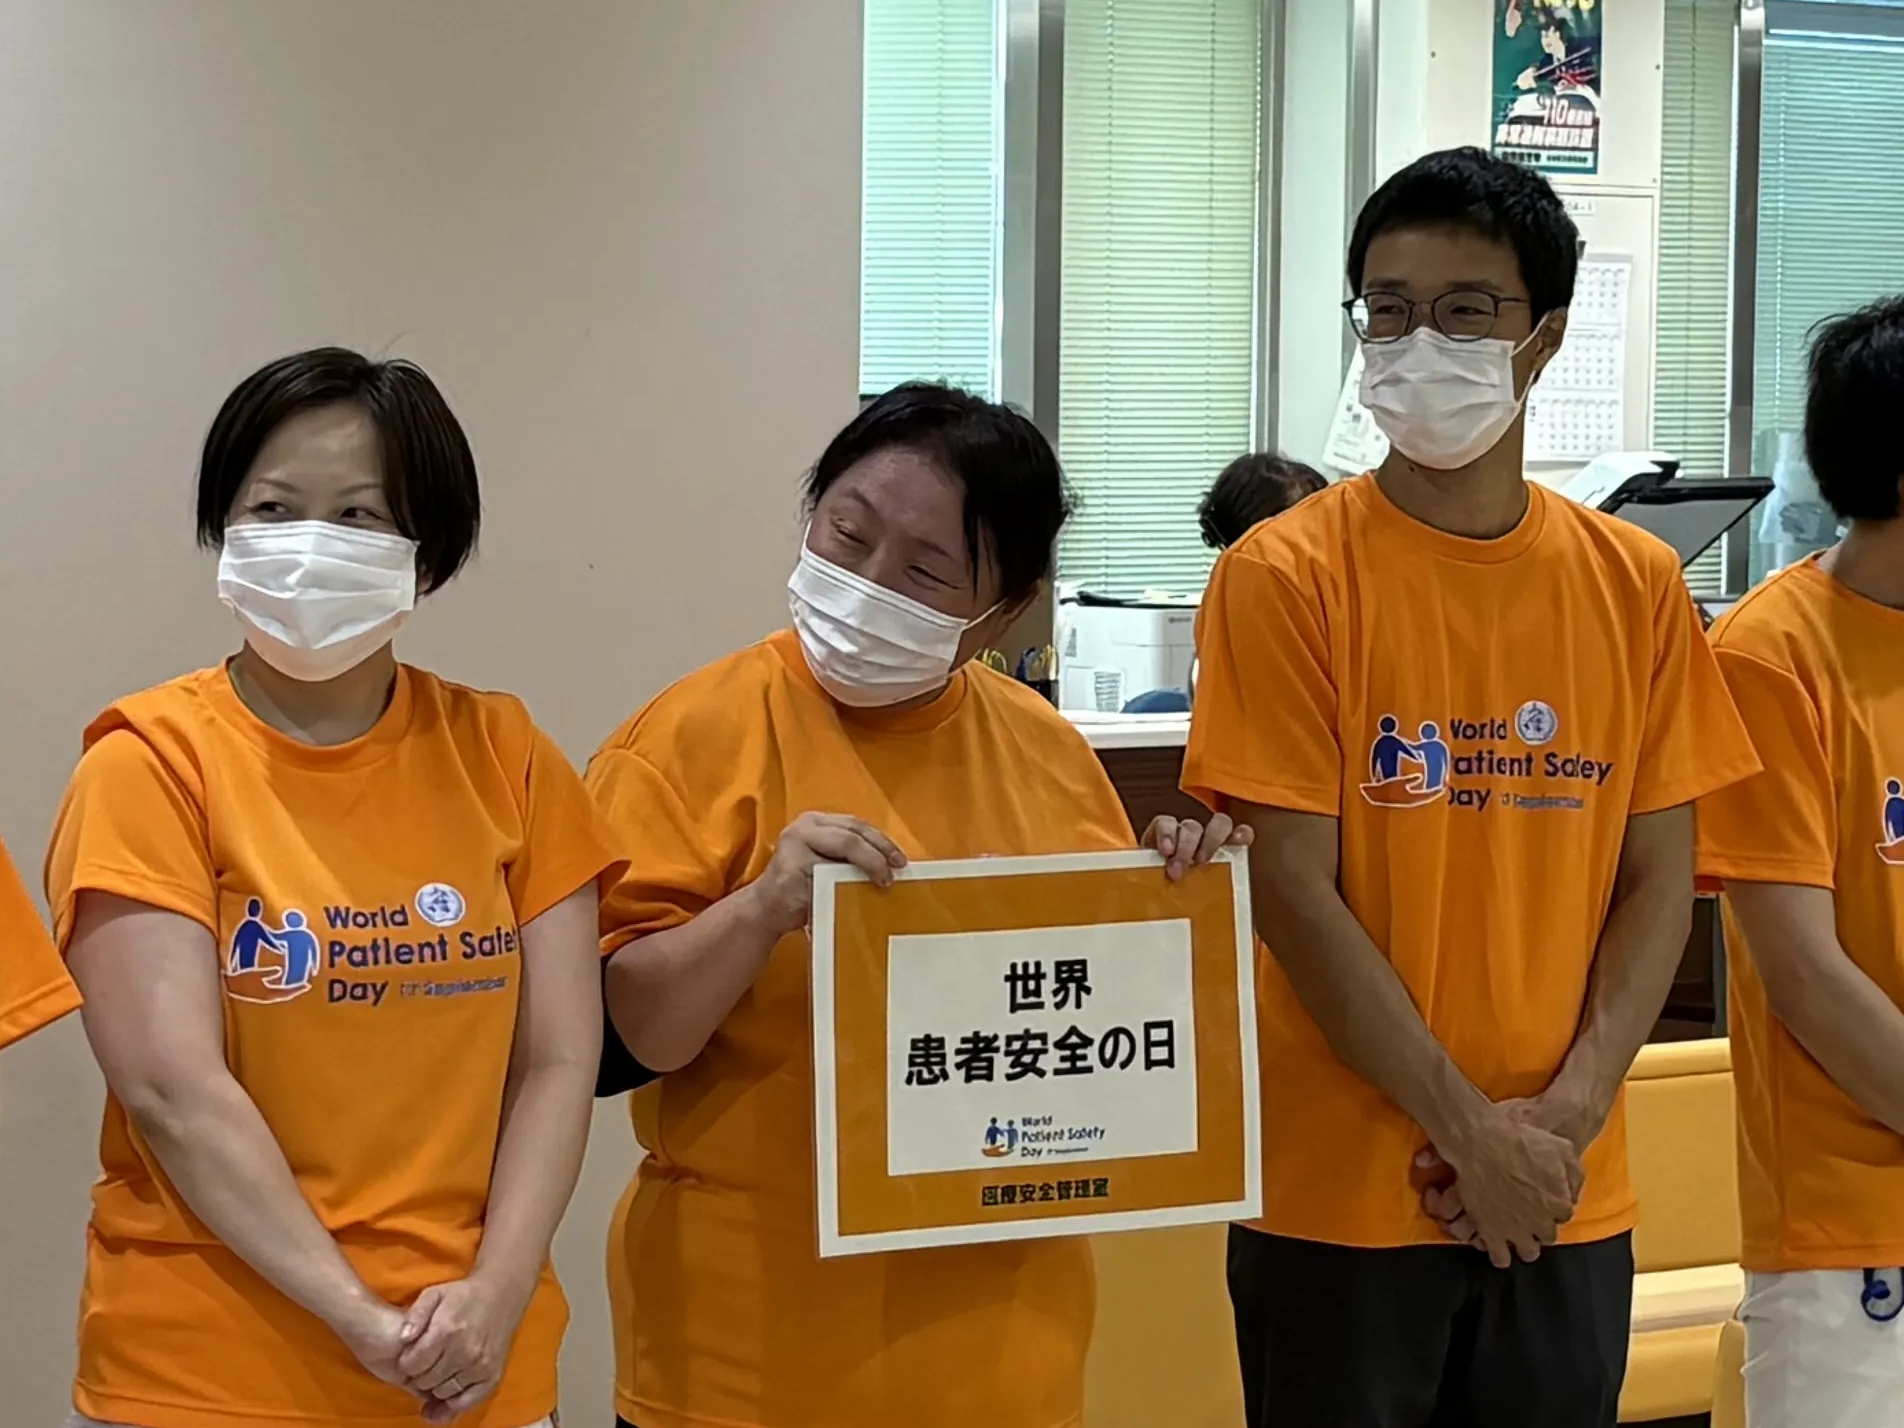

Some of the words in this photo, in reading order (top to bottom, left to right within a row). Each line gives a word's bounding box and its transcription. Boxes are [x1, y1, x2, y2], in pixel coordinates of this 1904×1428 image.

[1451, 750, 1535, 777] atient
[323, 903, 410, 929] World
[328, 932, 449, 969] Patient
[459, 924, 517, 960] Safe
[328, 977, 390, 1005] Day
[1004, 958, 1093, 1014] 世界
[905, 1019, 1177, 1087] 患者安全の日
[1021, 1128, 1065, 1143] Patient
[1067, 1126, 1105, 1140] Safety
[1020, 1146, 1043, 1158] Day
[982, 1178, 1109, 1207] 医療安全管理室
